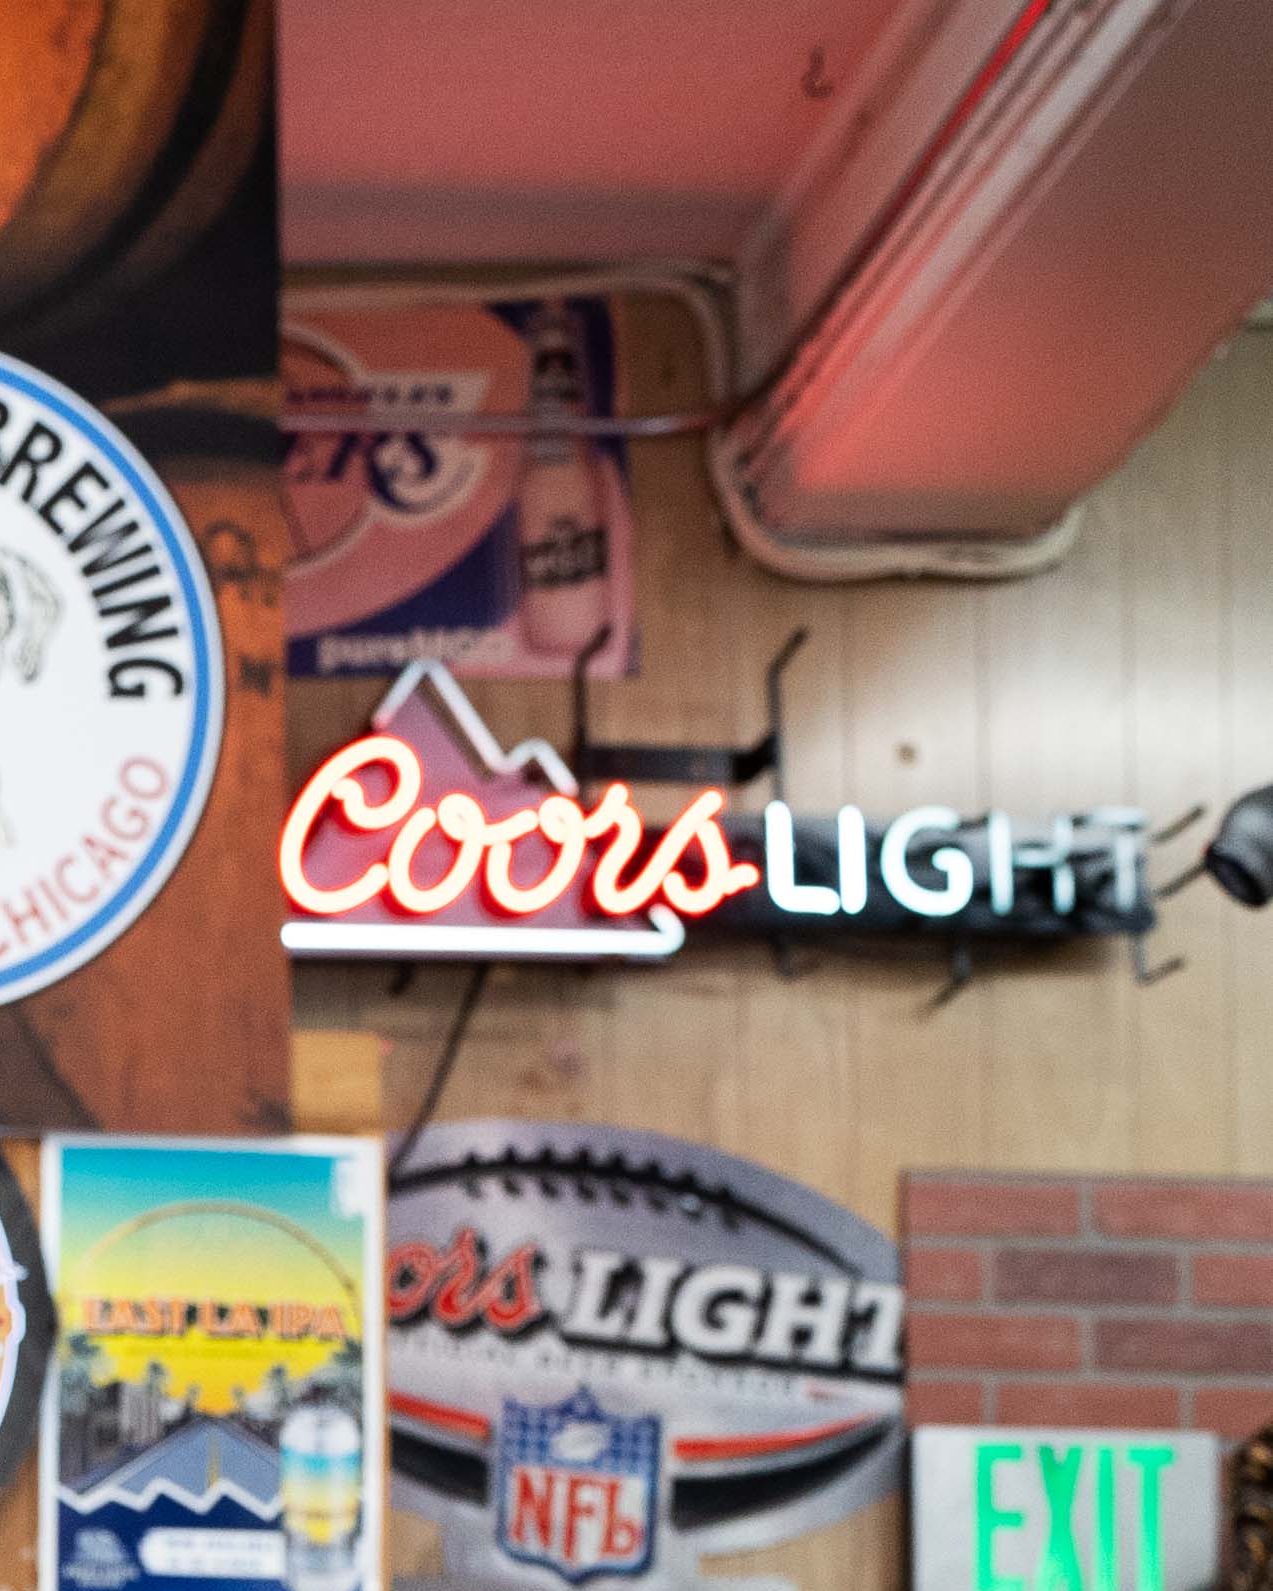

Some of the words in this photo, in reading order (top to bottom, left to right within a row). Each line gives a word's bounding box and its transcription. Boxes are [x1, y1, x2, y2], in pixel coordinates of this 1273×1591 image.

[280, 734, 759, 916] Coors
[762, 798, 1147, 916] LIGHT
[560, 1249, 905, 1372] LIGHT
[510, 1465, 645, 1562] NFL
